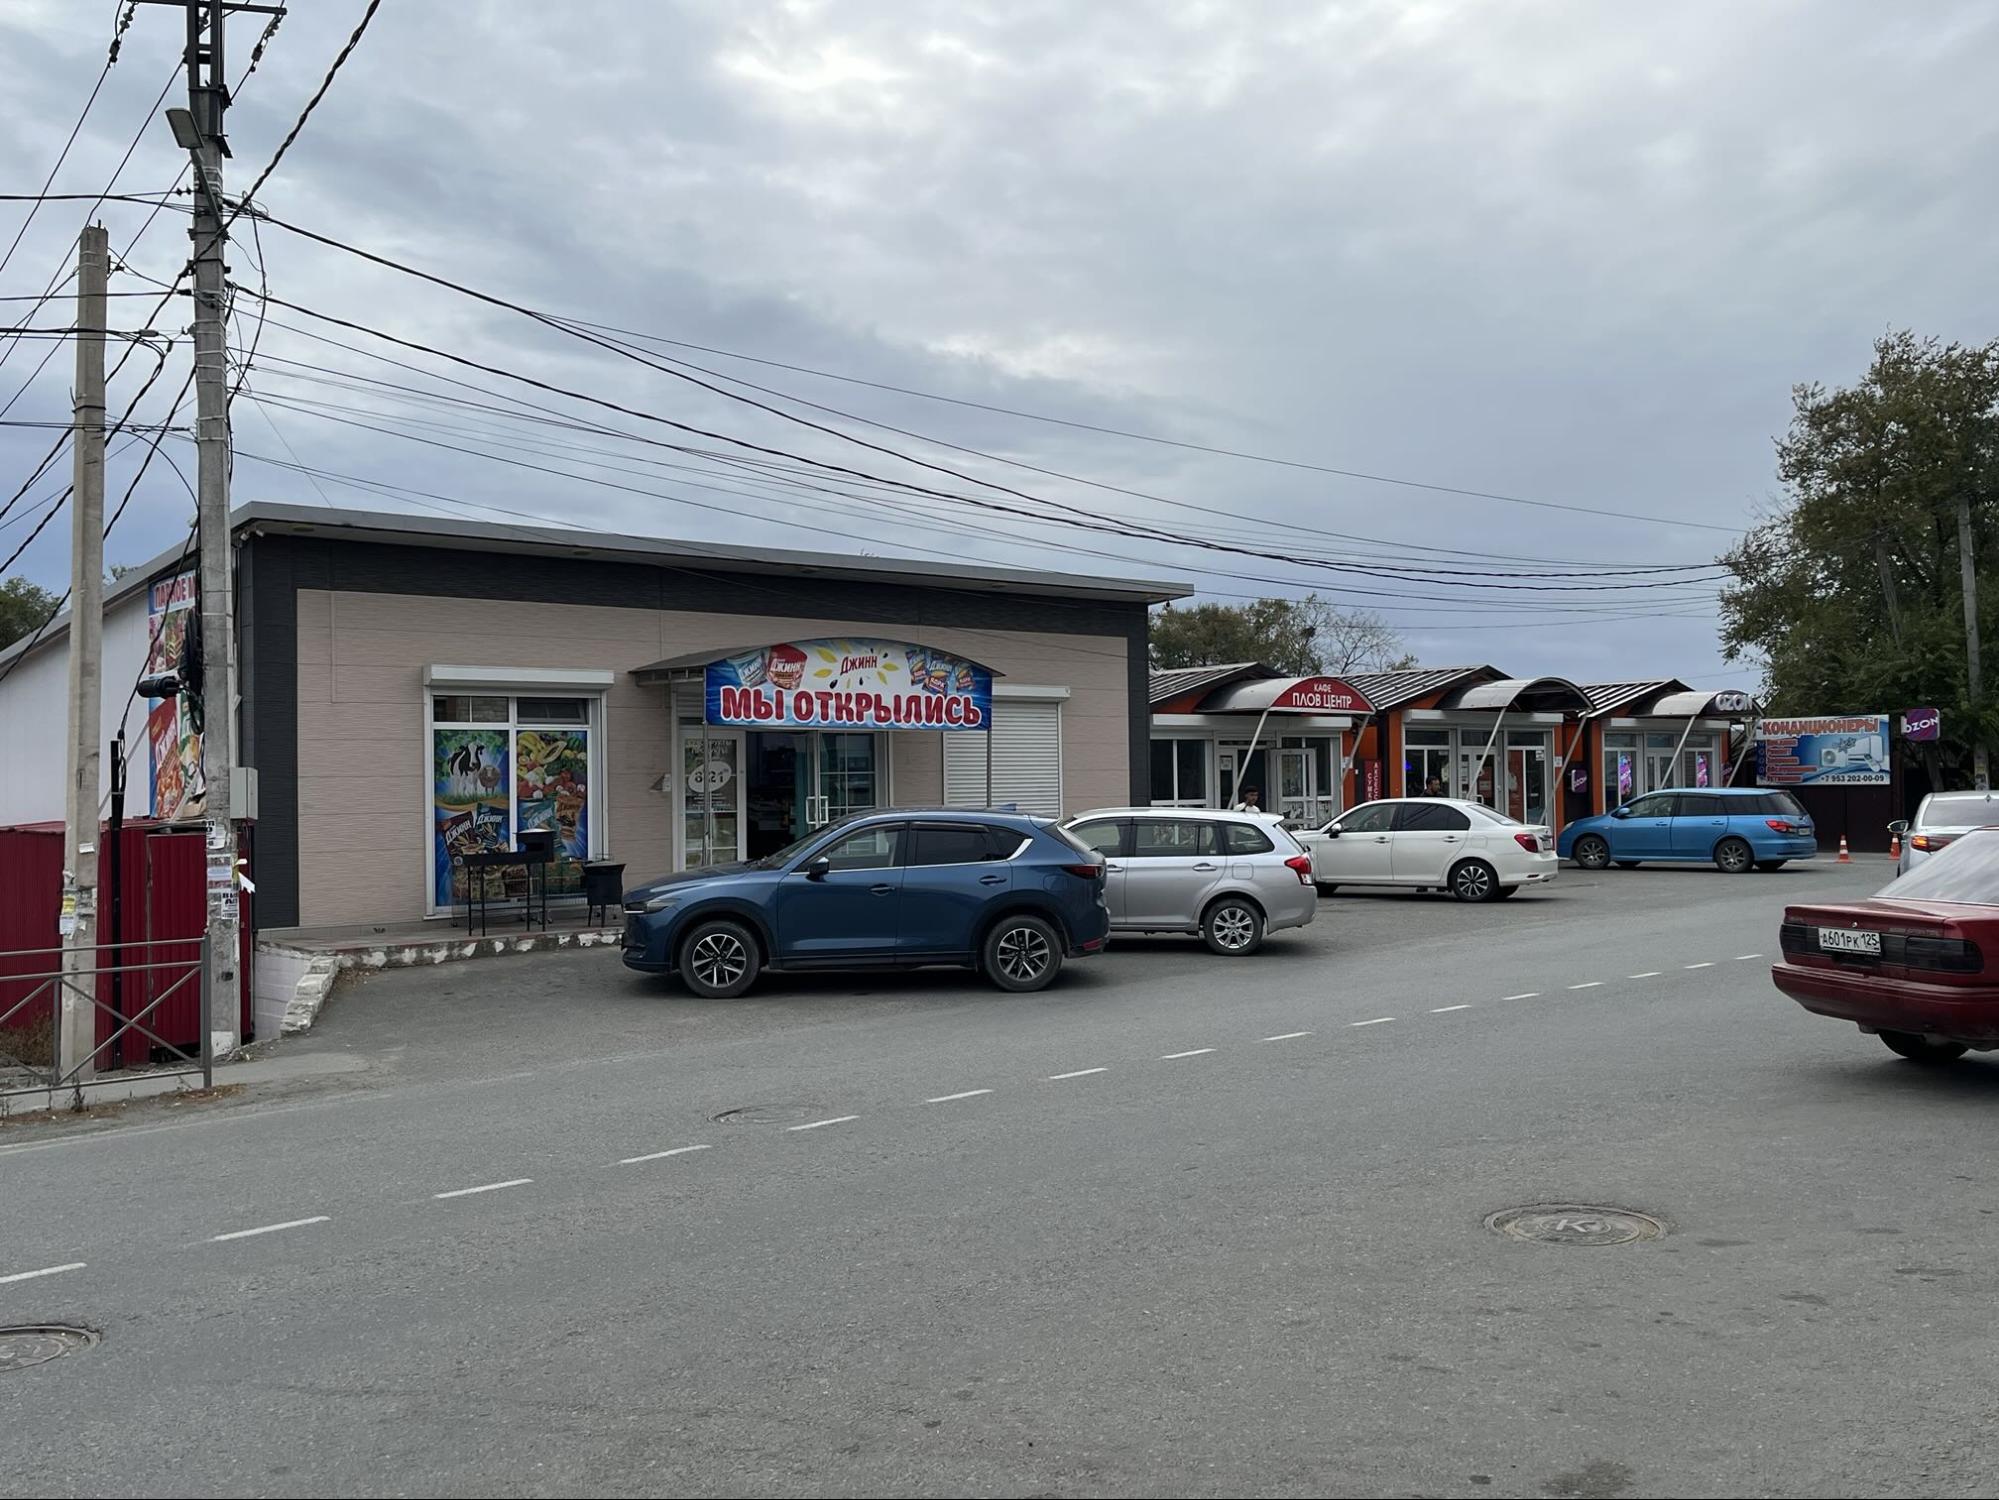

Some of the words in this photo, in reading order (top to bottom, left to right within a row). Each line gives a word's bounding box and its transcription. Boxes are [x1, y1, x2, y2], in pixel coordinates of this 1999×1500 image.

[1313, 683, 1332, 693] КАФЕ
[722, 687, 785, 721] МЫ
[793, 690, 981, 726] ОТКРЫЛИСЬ
[1292, 692, 1322, 707] ПЛОВ
[1323, 694, 1353, 709] ЦЕНТР
[1715, 693, 1754, 711] OZON
[1762, 718, 1879, 736] КОНДИЦИОНЕРЫ
